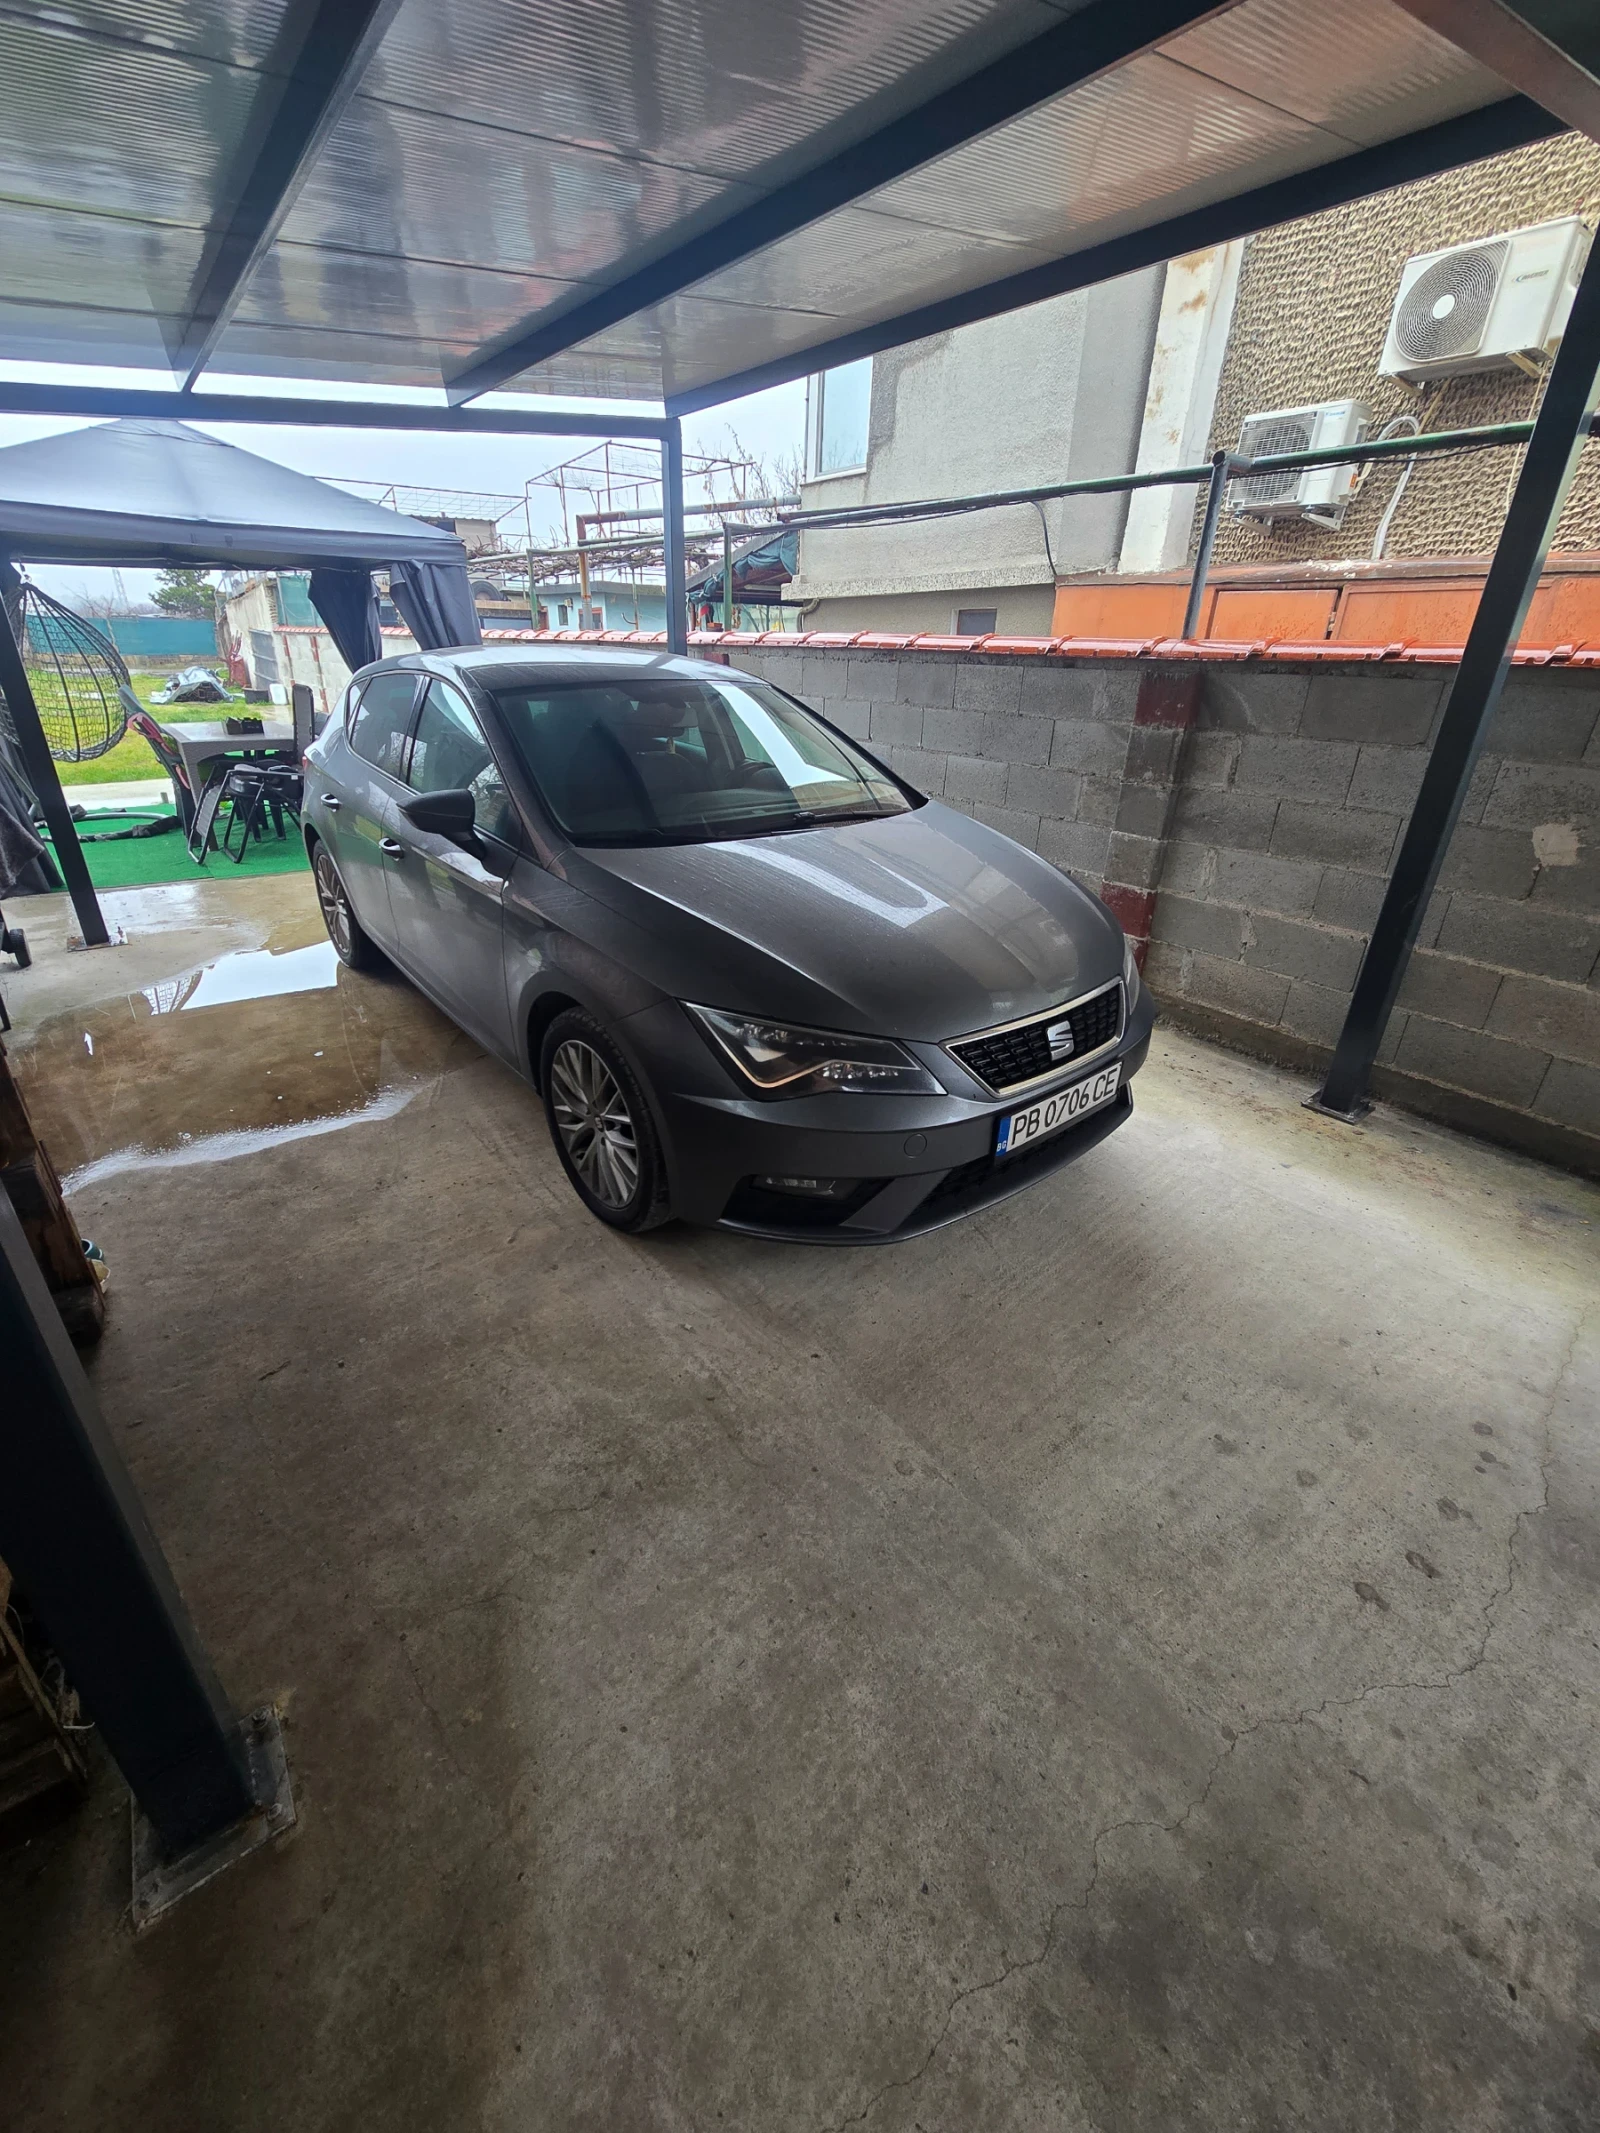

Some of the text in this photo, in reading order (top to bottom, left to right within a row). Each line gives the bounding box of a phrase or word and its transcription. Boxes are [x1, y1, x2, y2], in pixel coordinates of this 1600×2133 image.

[1011, 1068, 1118, 1146] PB 0706 CE
[996, 1140, 1007, 1152] BG
